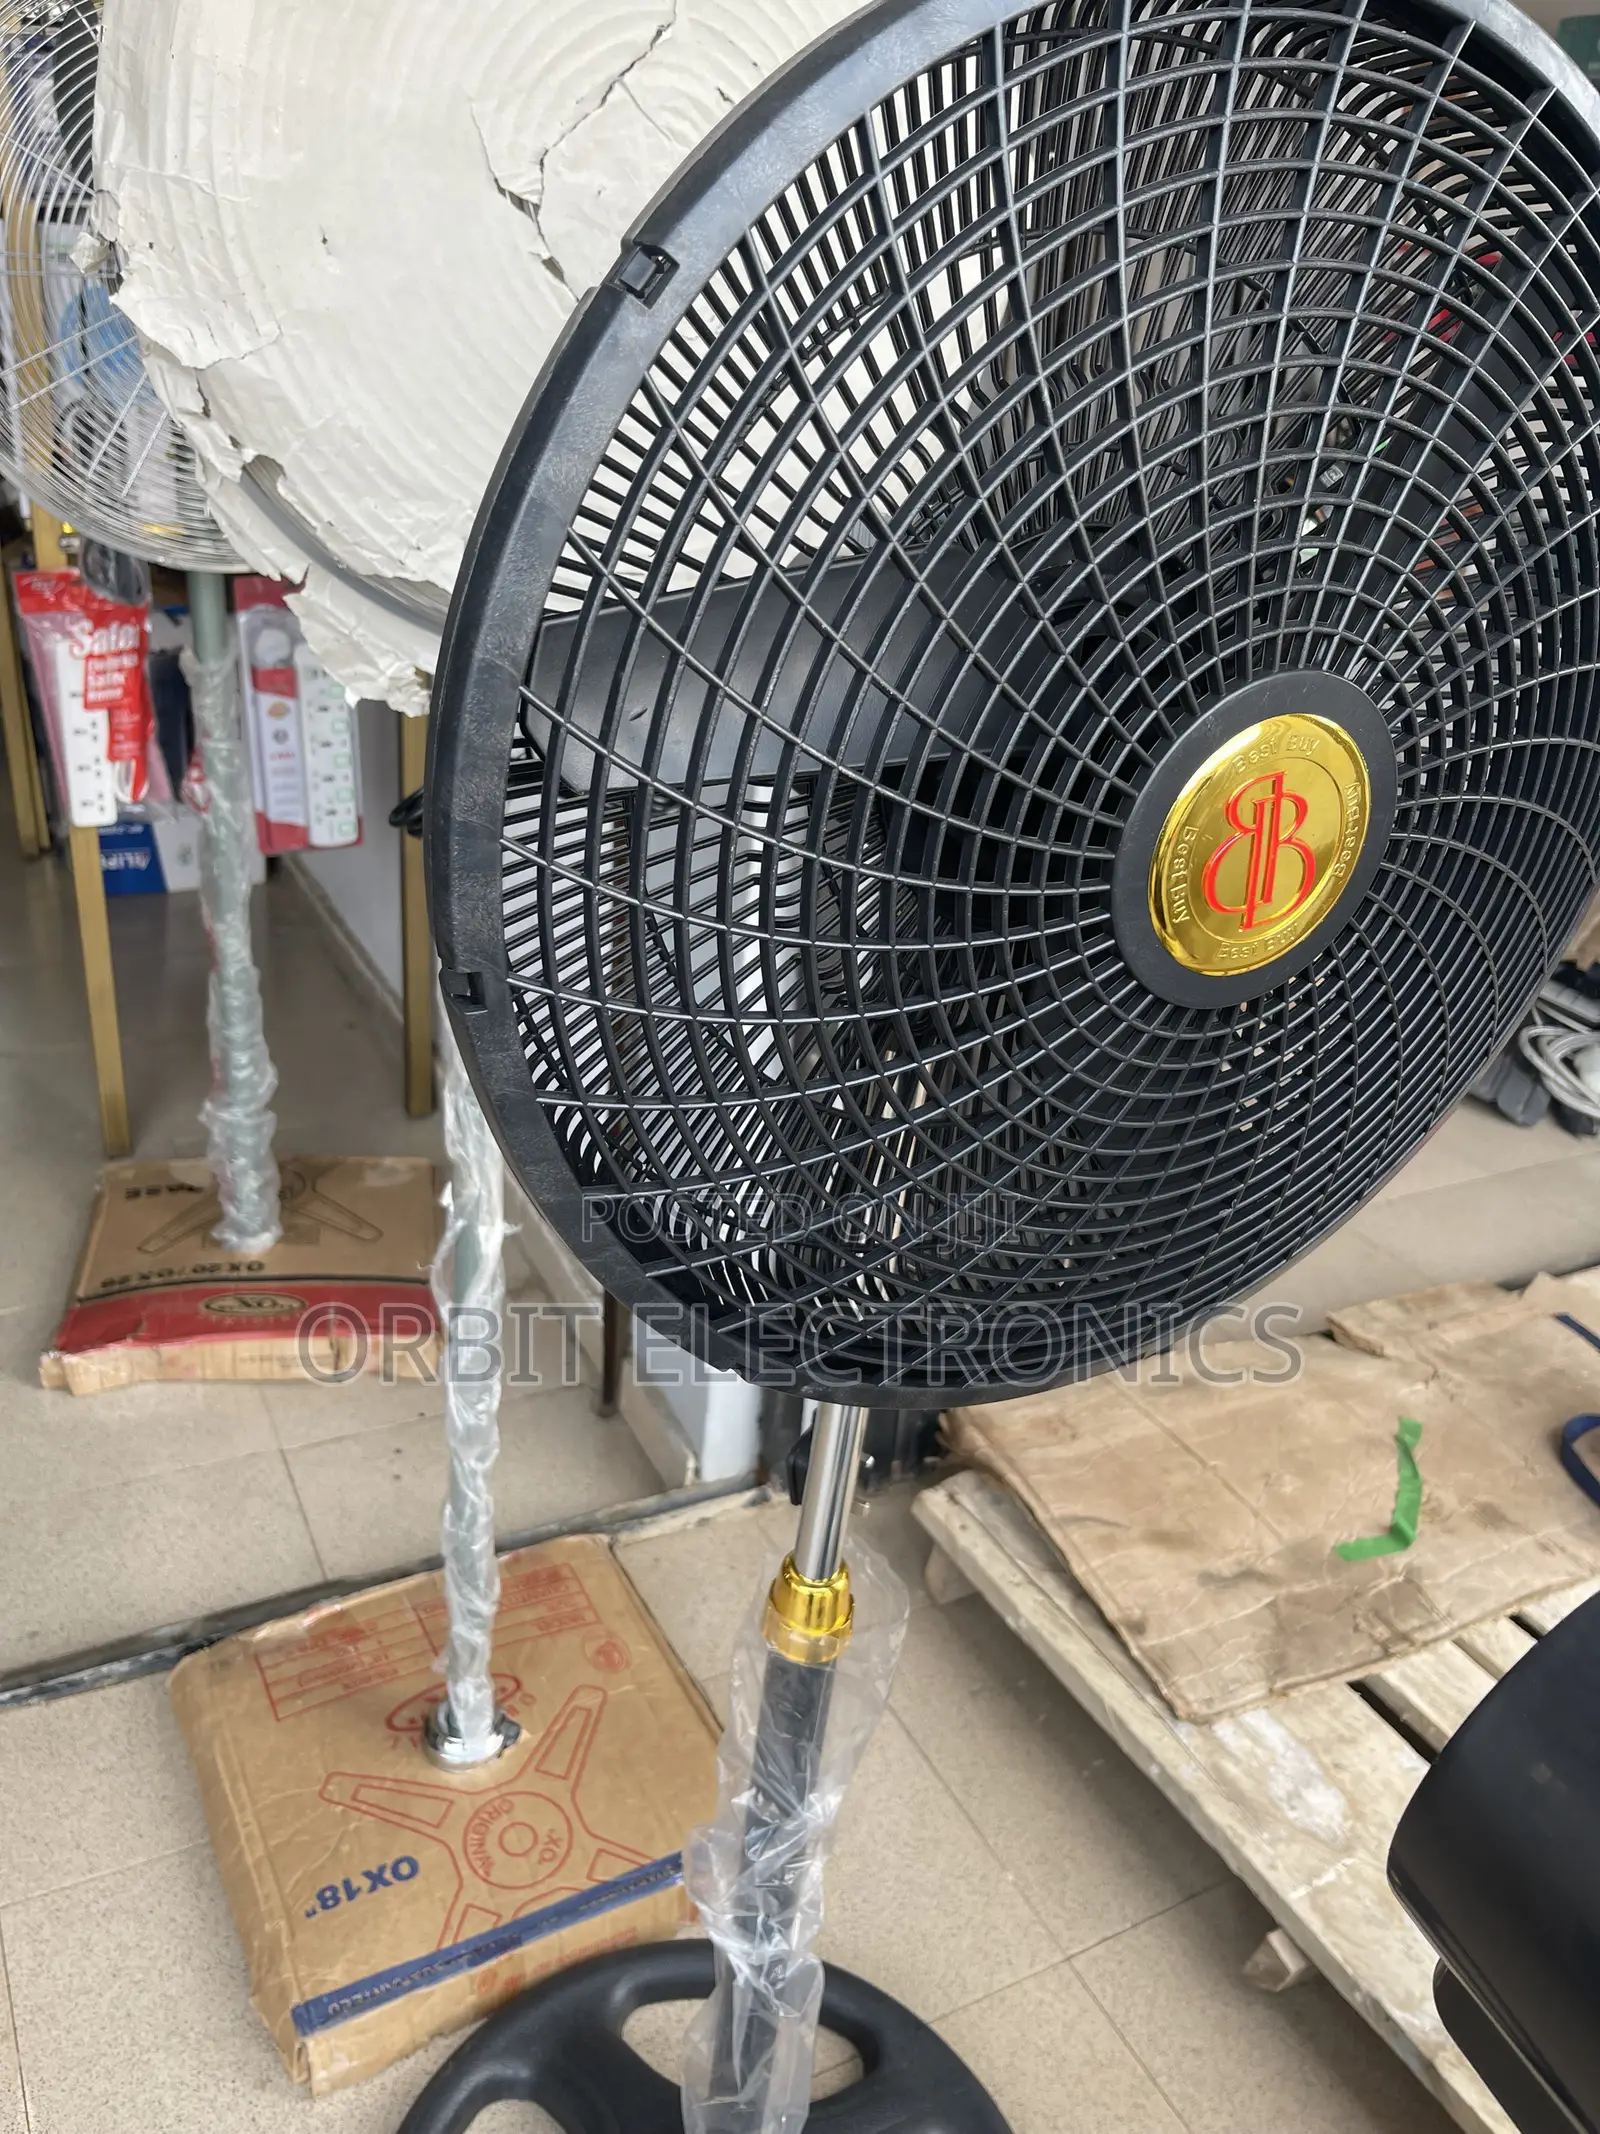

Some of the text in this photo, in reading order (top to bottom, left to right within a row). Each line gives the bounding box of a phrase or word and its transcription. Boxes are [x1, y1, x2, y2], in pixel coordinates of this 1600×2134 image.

[1231, 732, 1320, 774] Best Buy
[1334, 782, 1361, 878] Best Buy
[1170, 826, 1200, 924] Best Buy
[1216, 923, 1299, 960] Best Buy
